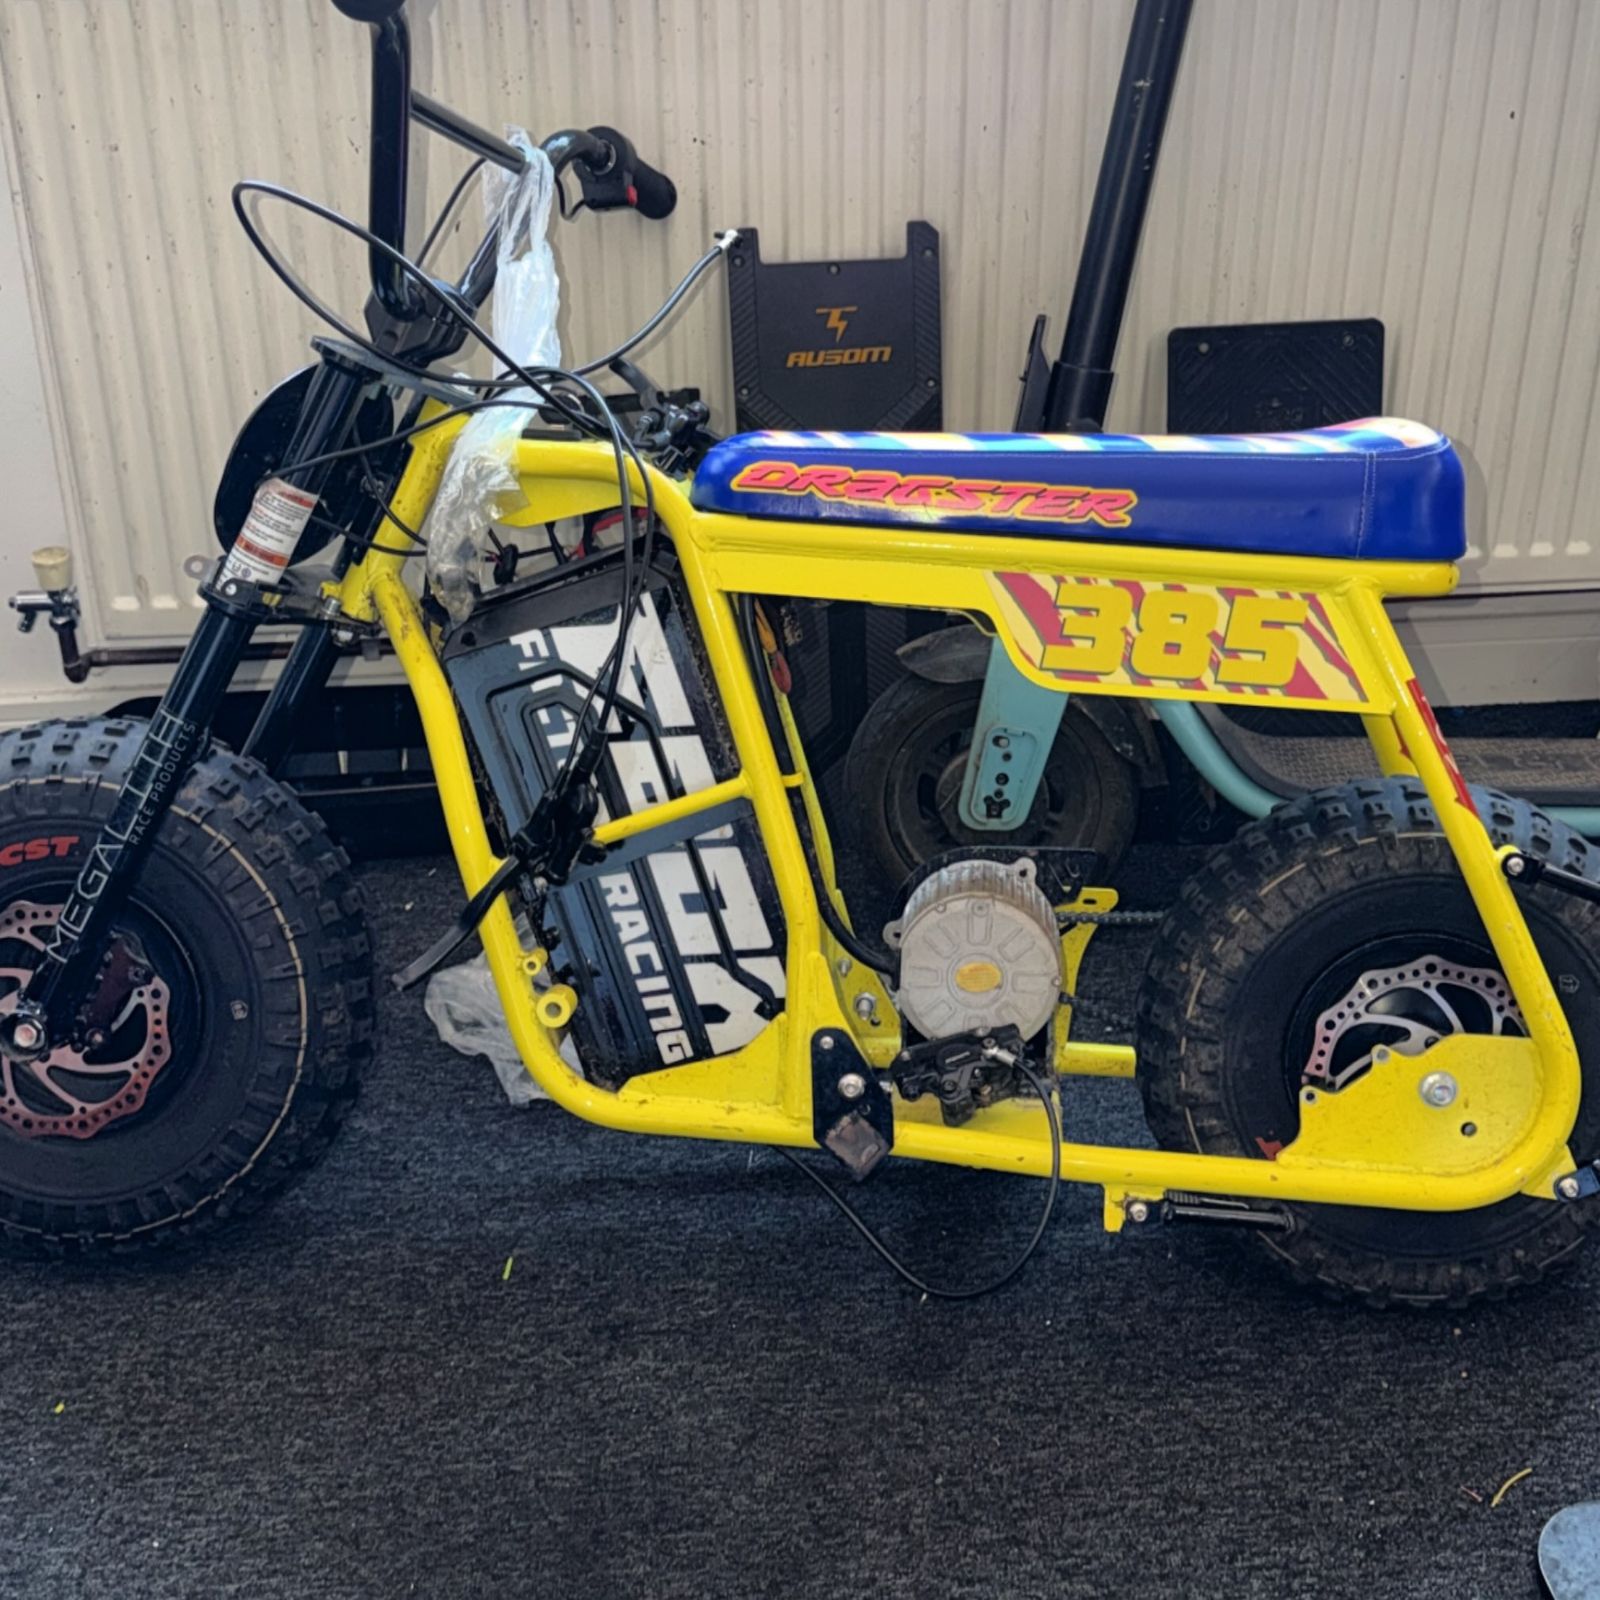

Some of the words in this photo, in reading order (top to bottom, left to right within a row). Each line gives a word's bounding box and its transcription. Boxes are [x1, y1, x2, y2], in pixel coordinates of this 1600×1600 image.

[786, 346, 892, 368] AUSOM
[1040, 583, 1309, 687] 385
[46, 709, 184, 963] MEGALITH
[128, 806, 156, 846] RACE
[150, 721, 196, 803] PRODUCTS
[0, 836, 79, 866] CST
[600, 872, 694, 1065] RACING
